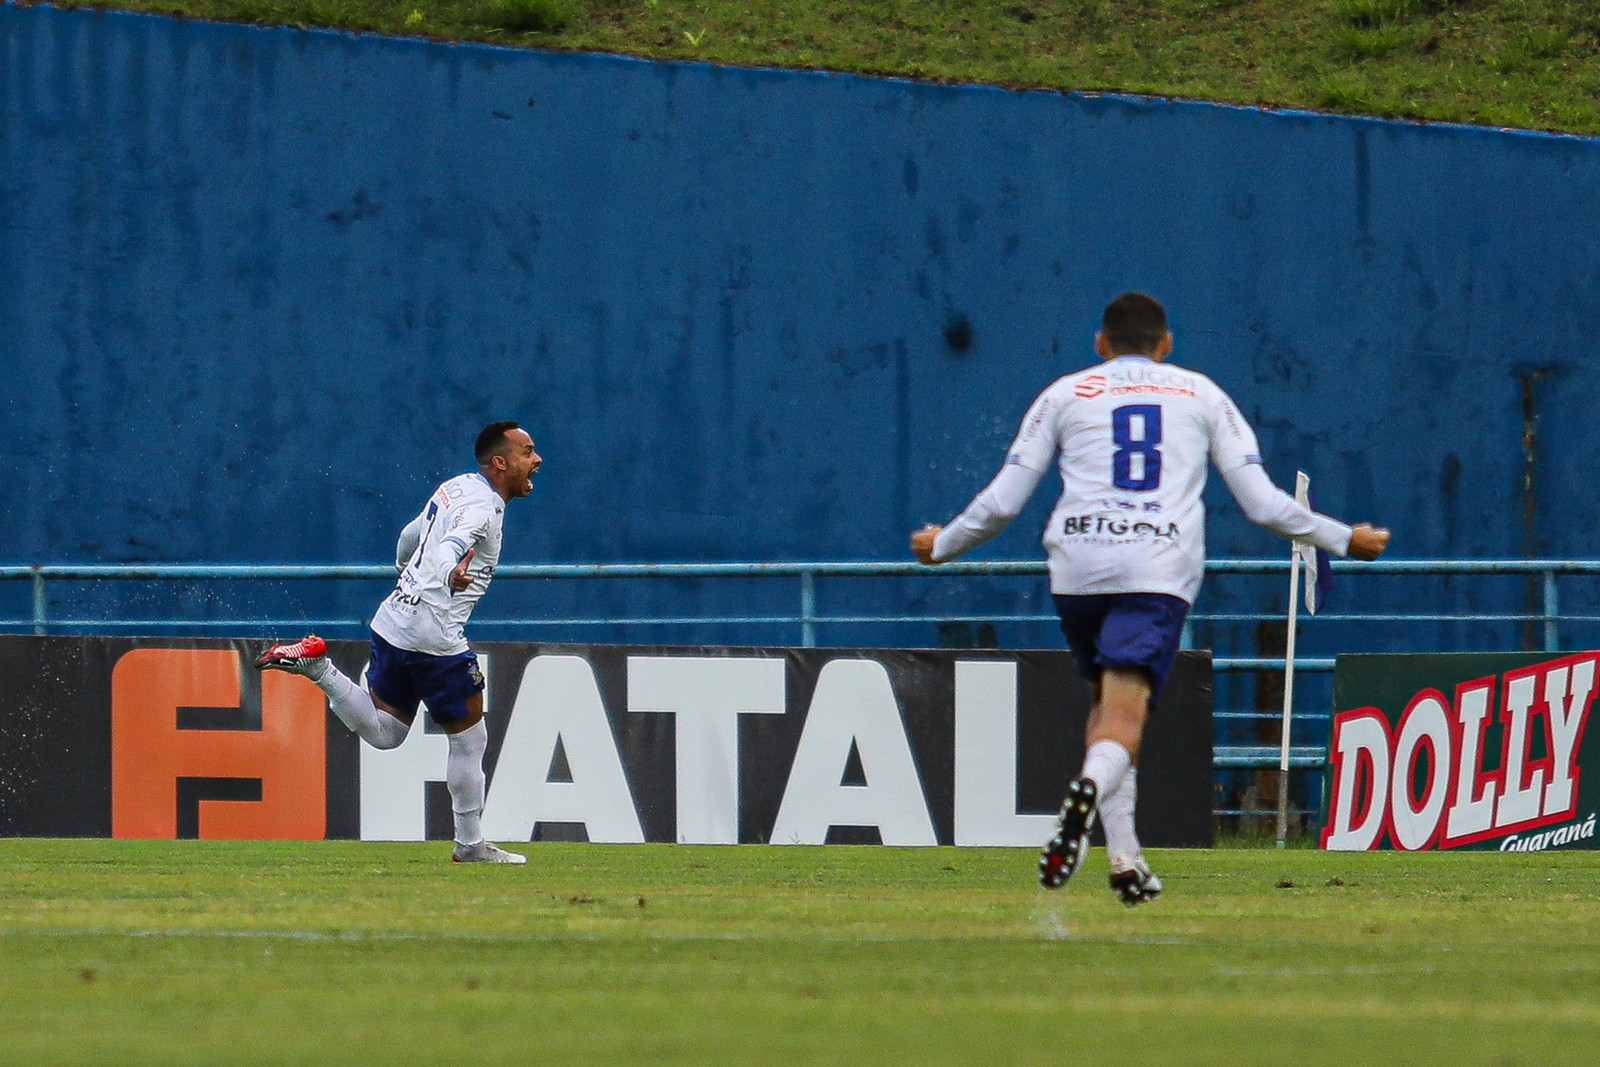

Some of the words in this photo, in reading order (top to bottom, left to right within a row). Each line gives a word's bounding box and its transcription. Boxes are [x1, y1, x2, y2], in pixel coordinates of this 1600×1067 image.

[1112, 404, 1162, 491] 8
[414, 500, 438, 570] 7
[360, 653, 1060, 849] FATAL
[1325, 657, 1597, 850] DOLLY
[1500, 813, 1596, 851] Guaraná
